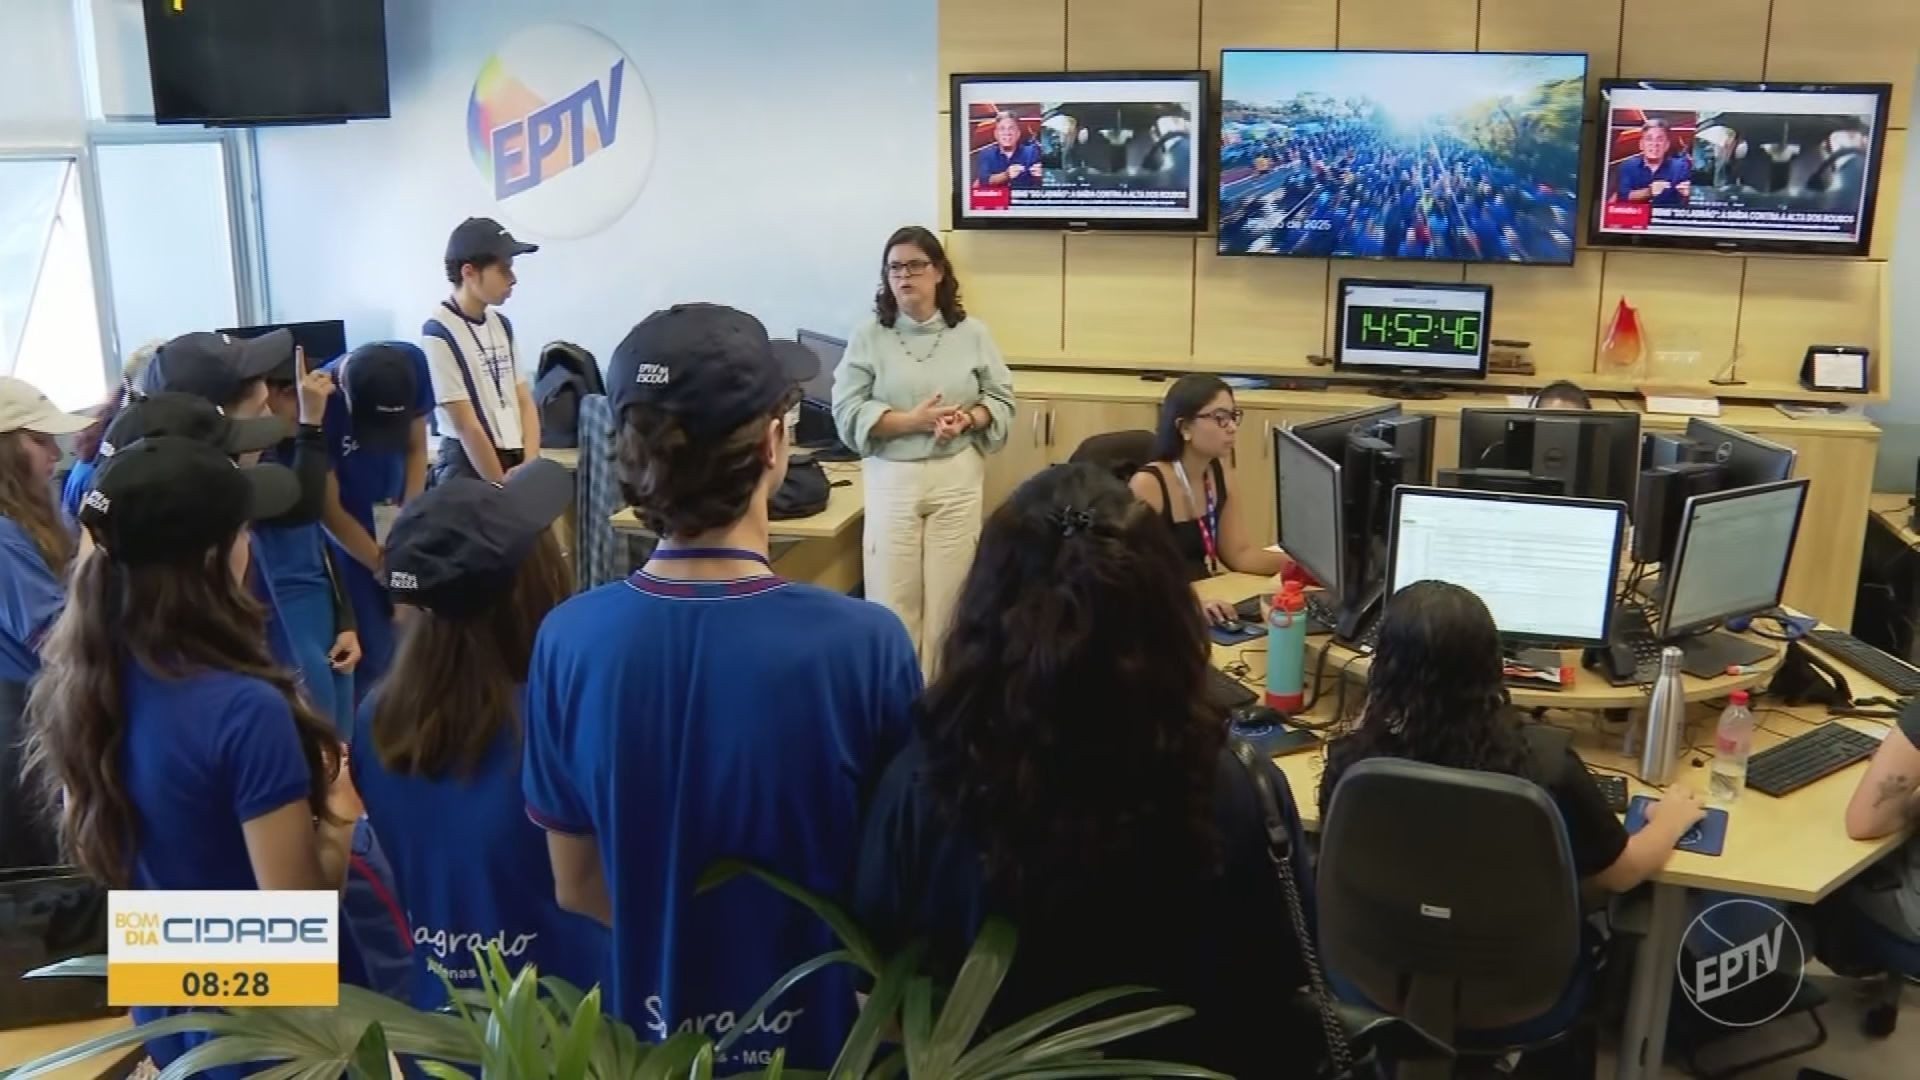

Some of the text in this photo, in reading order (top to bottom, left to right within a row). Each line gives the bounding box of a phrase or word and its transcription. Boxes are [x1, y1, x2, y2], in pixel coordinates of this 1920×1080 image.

[491, 57, 625, 201] EPTV
[1361, 312, 1478, 350] 14:52:46
[407, 909, 538, 959] agrado
